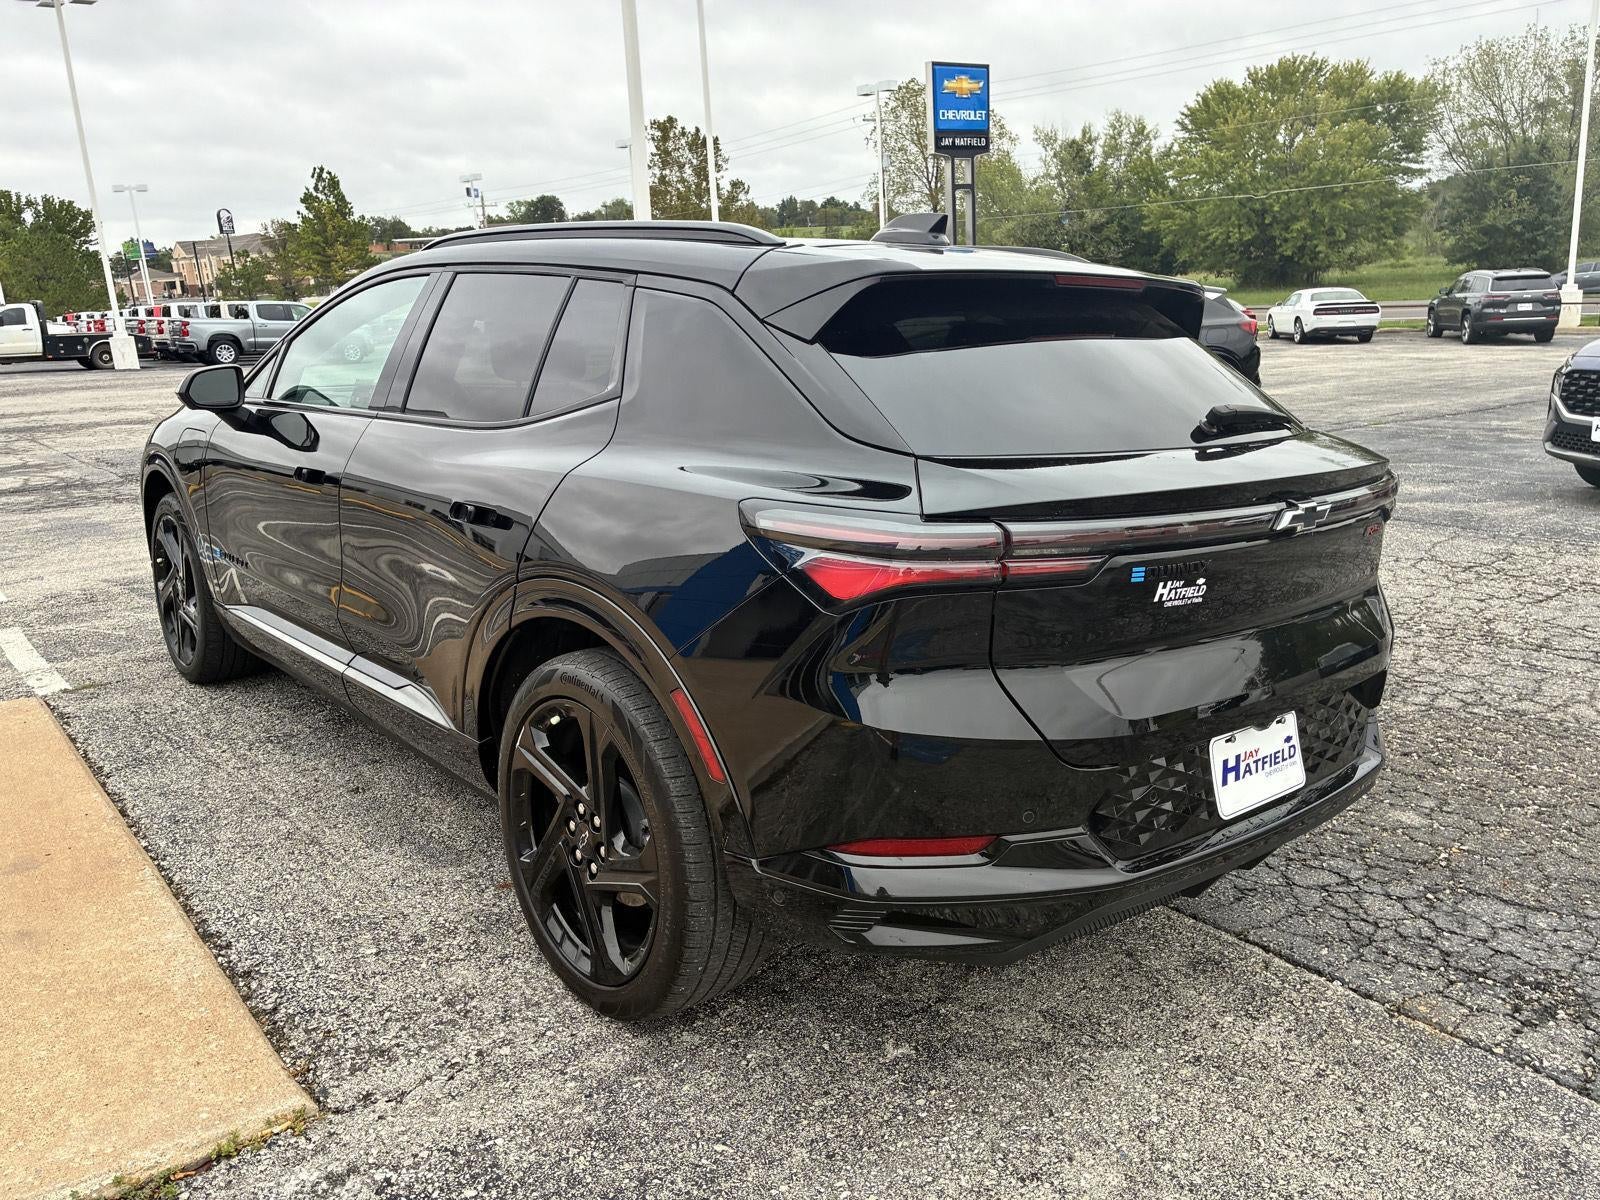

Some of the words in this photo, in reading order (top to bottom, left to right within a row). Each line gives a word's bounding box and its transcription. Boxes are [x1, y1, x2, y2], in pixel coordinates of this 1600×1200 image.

[939, 109, 986, 120] CHEVROLET
[940, 138, 952, 146] JAY
[955, 138, 986, 146] HATFIELD
[1153, 581, 1207, 602] HATFIELD
[1170, 580, 1184, 589] JAY
[560, 671, 599, 699] Continental
[1242, 748, 1260, 762] JAY
[1221, 744, 1297, 788] HATFIELD
